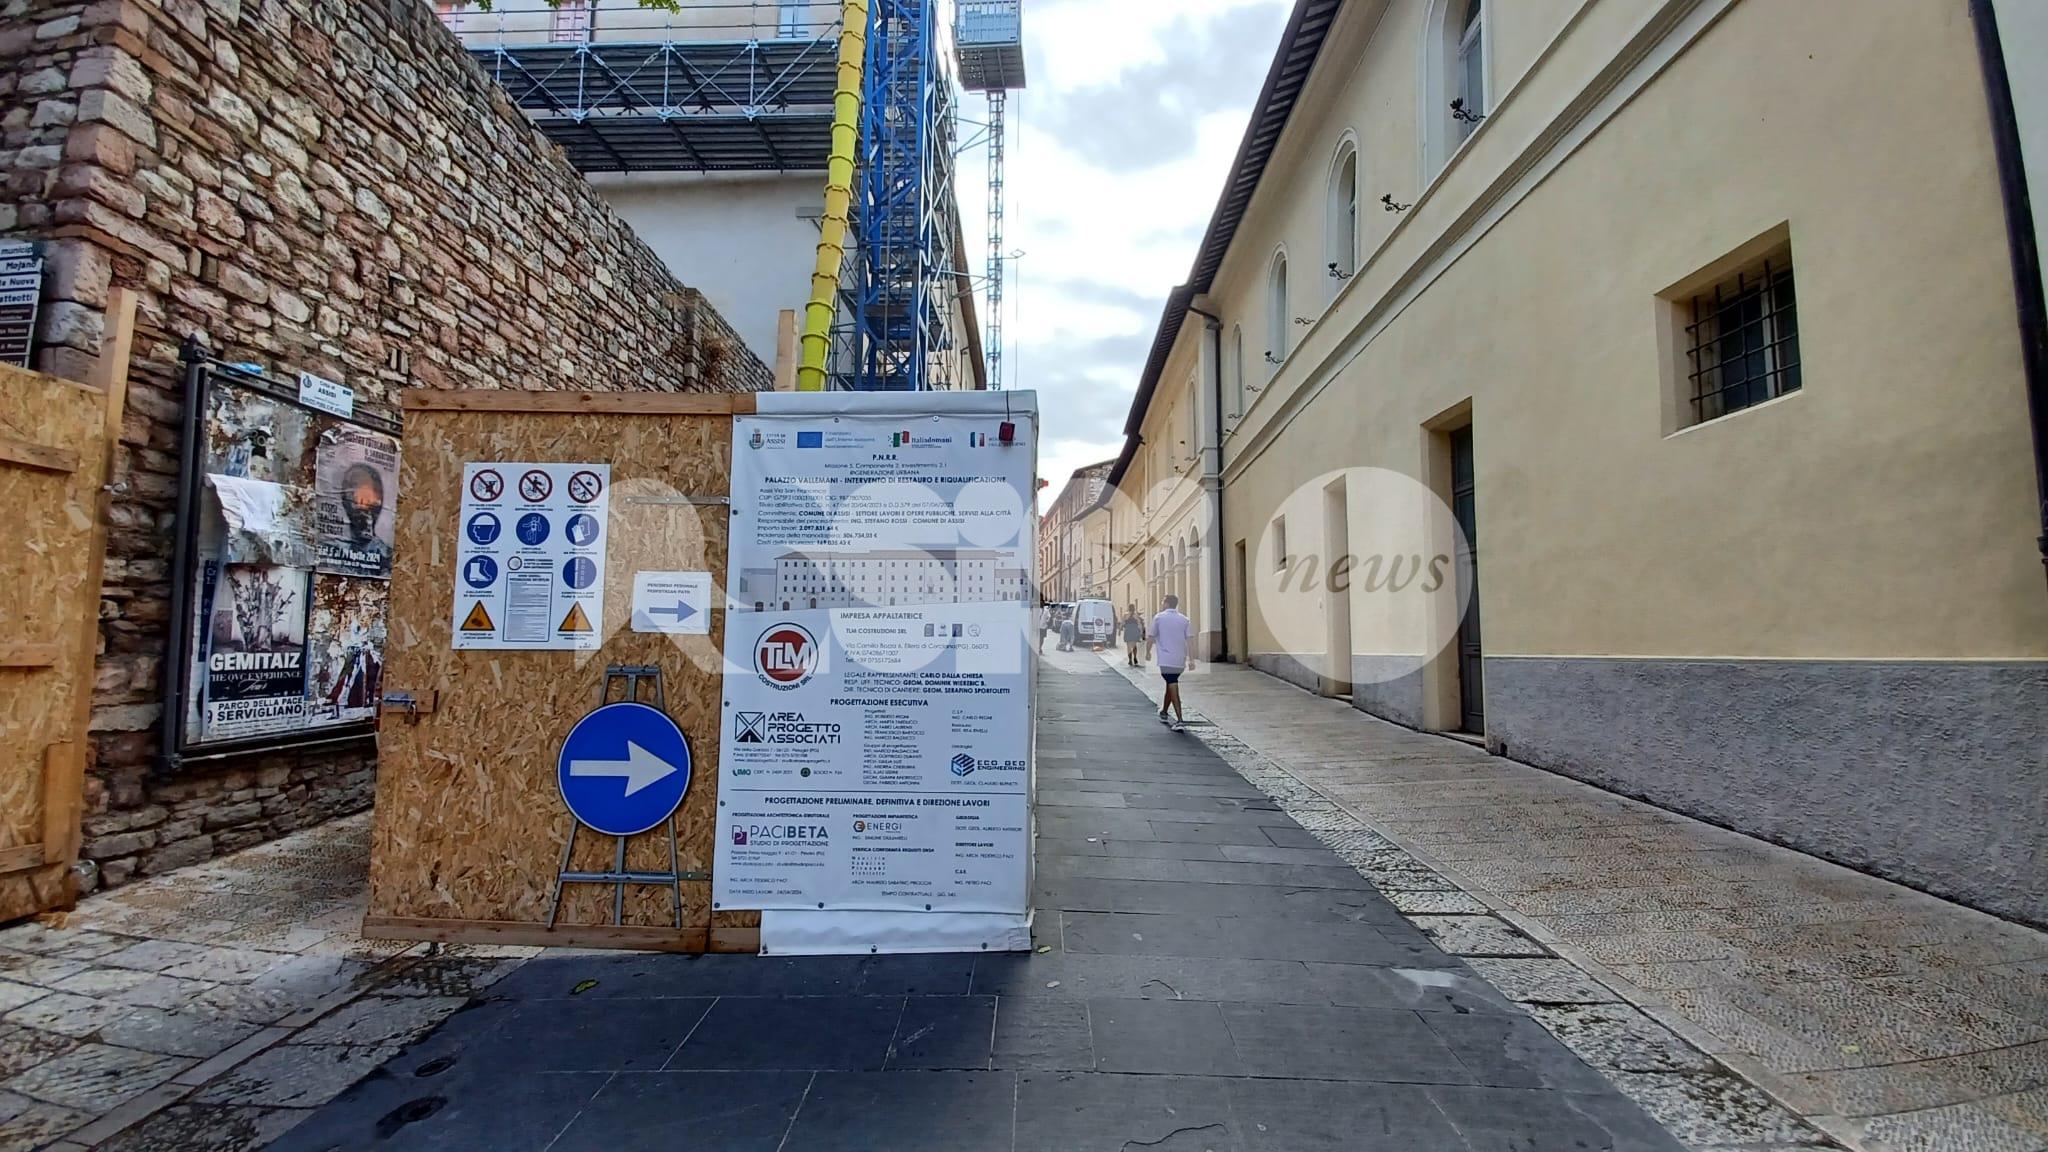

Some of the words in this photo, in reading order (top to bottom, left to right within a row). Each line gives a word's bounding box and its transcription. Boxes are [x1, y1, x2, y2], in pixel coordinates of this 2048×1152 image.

[10, 278, 34, 286] Nuova
[761, 642, 811, 670] TLM
[210, 652, 300, 672] GEMITAIZ
[248, 672, 302, 681] EXPERIENCE
[758, 673, 800, 692] COSTRUZIONI
[800, 674, 814, 686] SRL
[218, 702, 249, 711] PARCO
[253, 698, 280, 708] DELLA
[282, 696, 303, 706] PACE
[768, 712, 805, 722] AREA
[768, 724, 840, 733] PROGETTO
[768, 734, 840, 744] ASSOCIATI
[867, 822, 902, 830] ENERGI
[750, 824, 829, 839] PACIBETA
